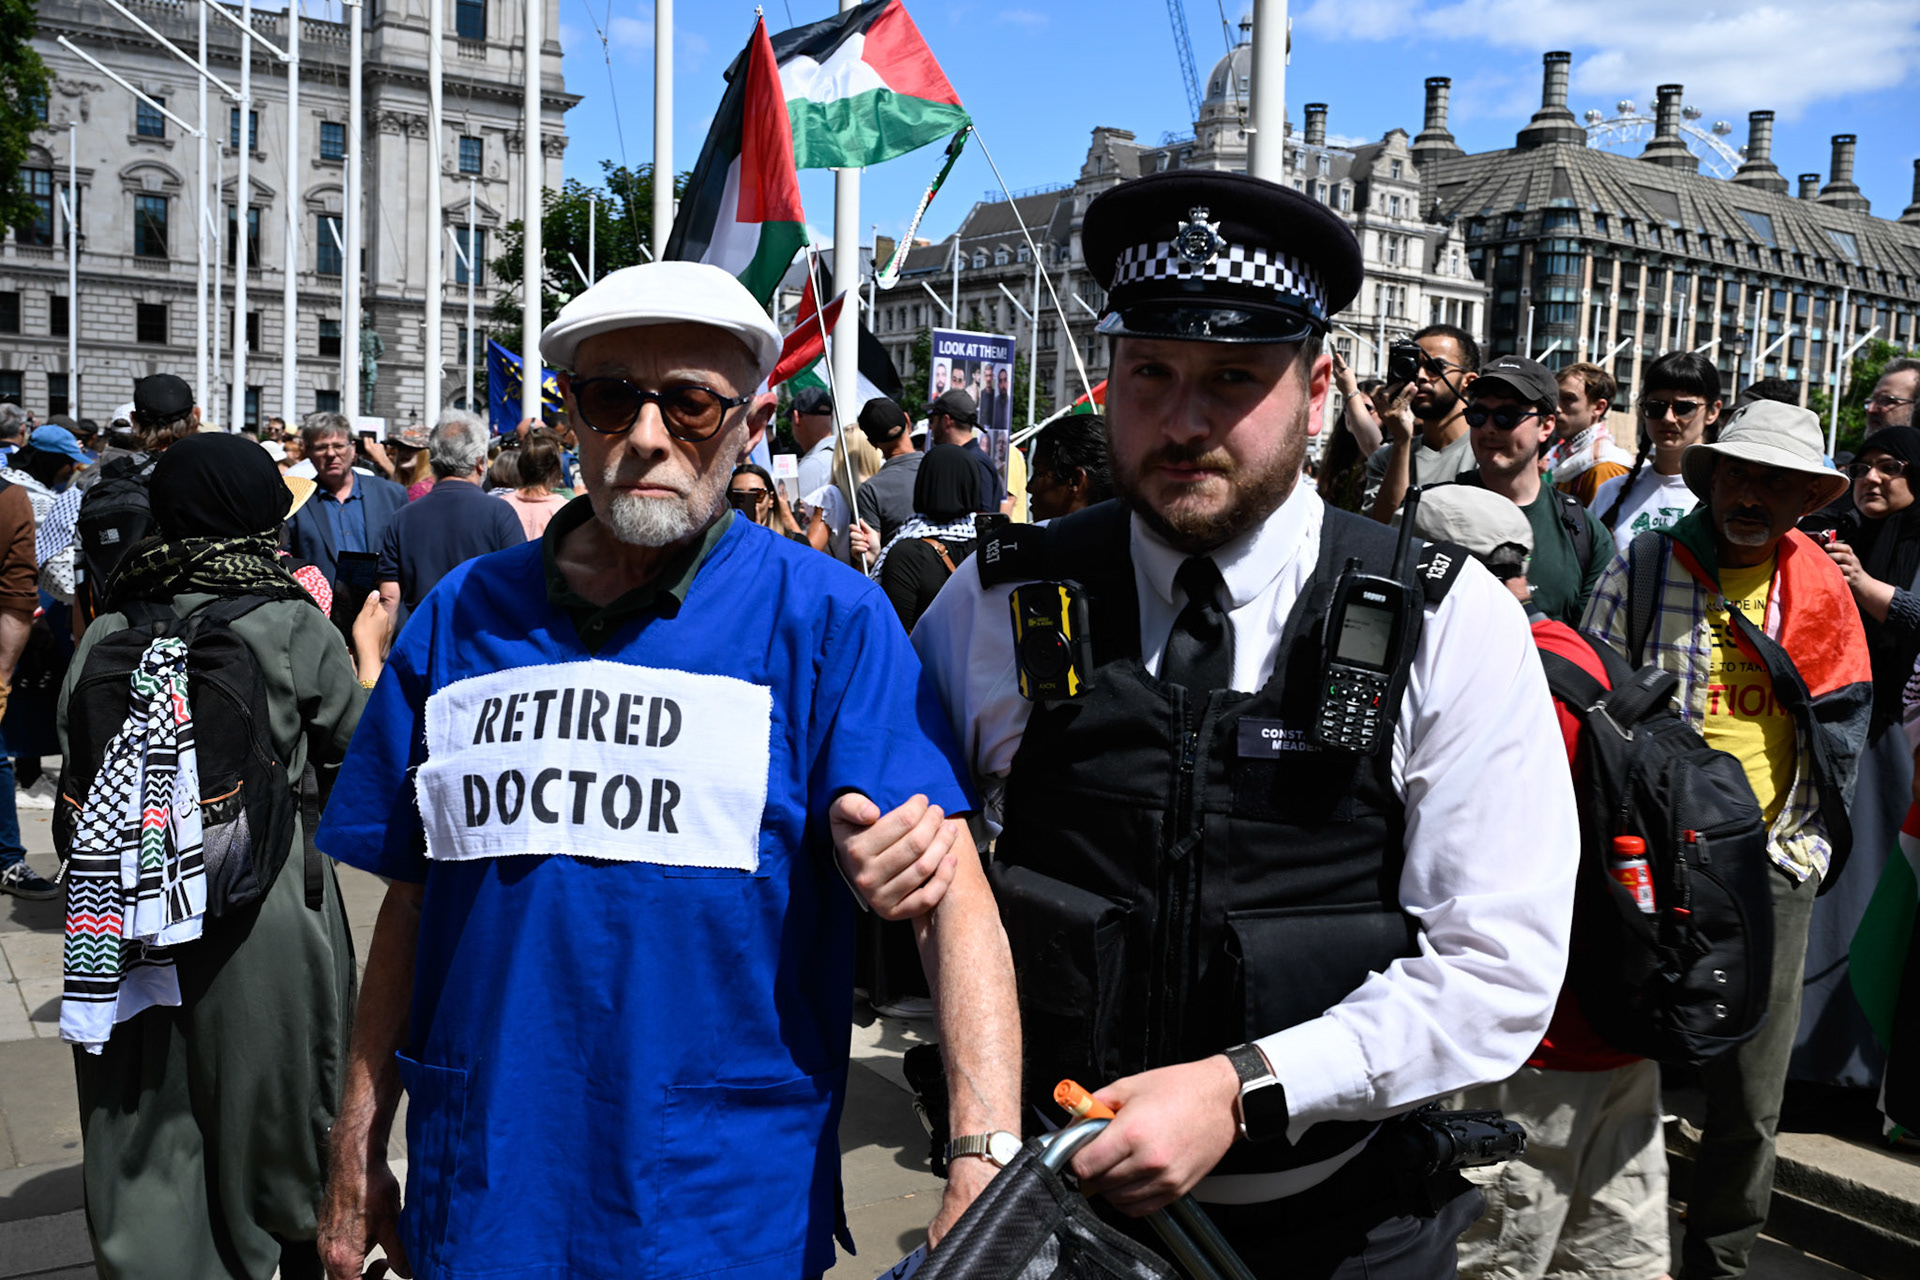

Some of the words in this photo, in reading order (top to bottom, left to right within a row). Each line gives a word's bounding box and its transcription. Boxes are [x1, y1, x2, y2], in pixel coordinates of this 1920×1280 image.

[939, 340, 965, 356] LOOK
[966, 343, 979, 357] AT
[979, 344, 1007, 359] THEM!
[985, 539, 1001, 565] 1337
[1426, 552, 1452, 579] 1337
[1362, 590, 1387, 603] sepura
[1753, 599, 1765, 610] IN
[1720, 662, 1736, 673] TO
[1740, 662, 1767, 673] TAK
[1707, 684, 1787, 717] TION
[472, 688, 682, 748] RETIRED
[1261, 728, 1306, 740] CONST.
[463, 767, 681, 834] DOCTOR
